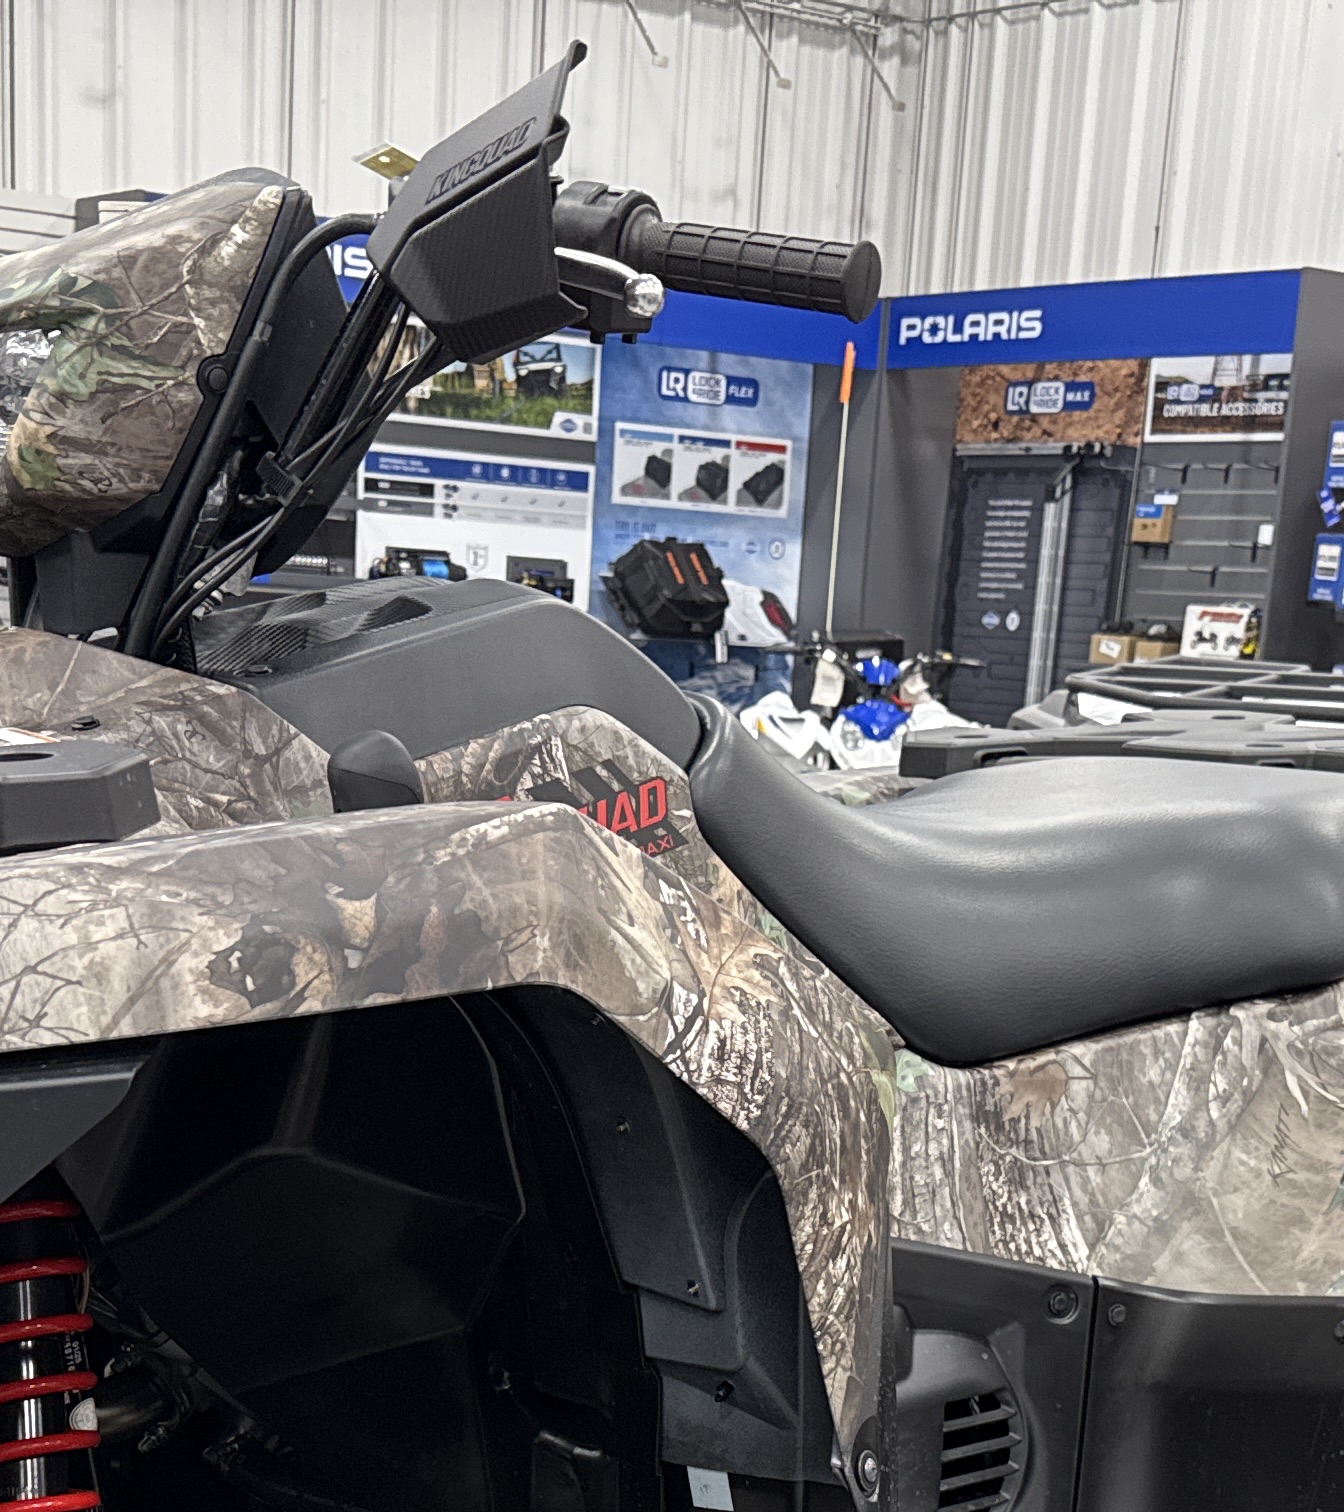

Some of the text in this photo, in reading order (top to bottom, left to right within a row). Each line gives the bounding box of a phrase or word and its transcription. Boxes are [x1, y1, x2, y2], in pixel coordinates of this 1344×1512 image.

[425, 116, 537, 206] KINGQUAD
[899, 309, 1044, 346] POLARIS
[728, 382, 755, 399] FLEX
[1220, 399, 1285, 417] ACCESSORIES
